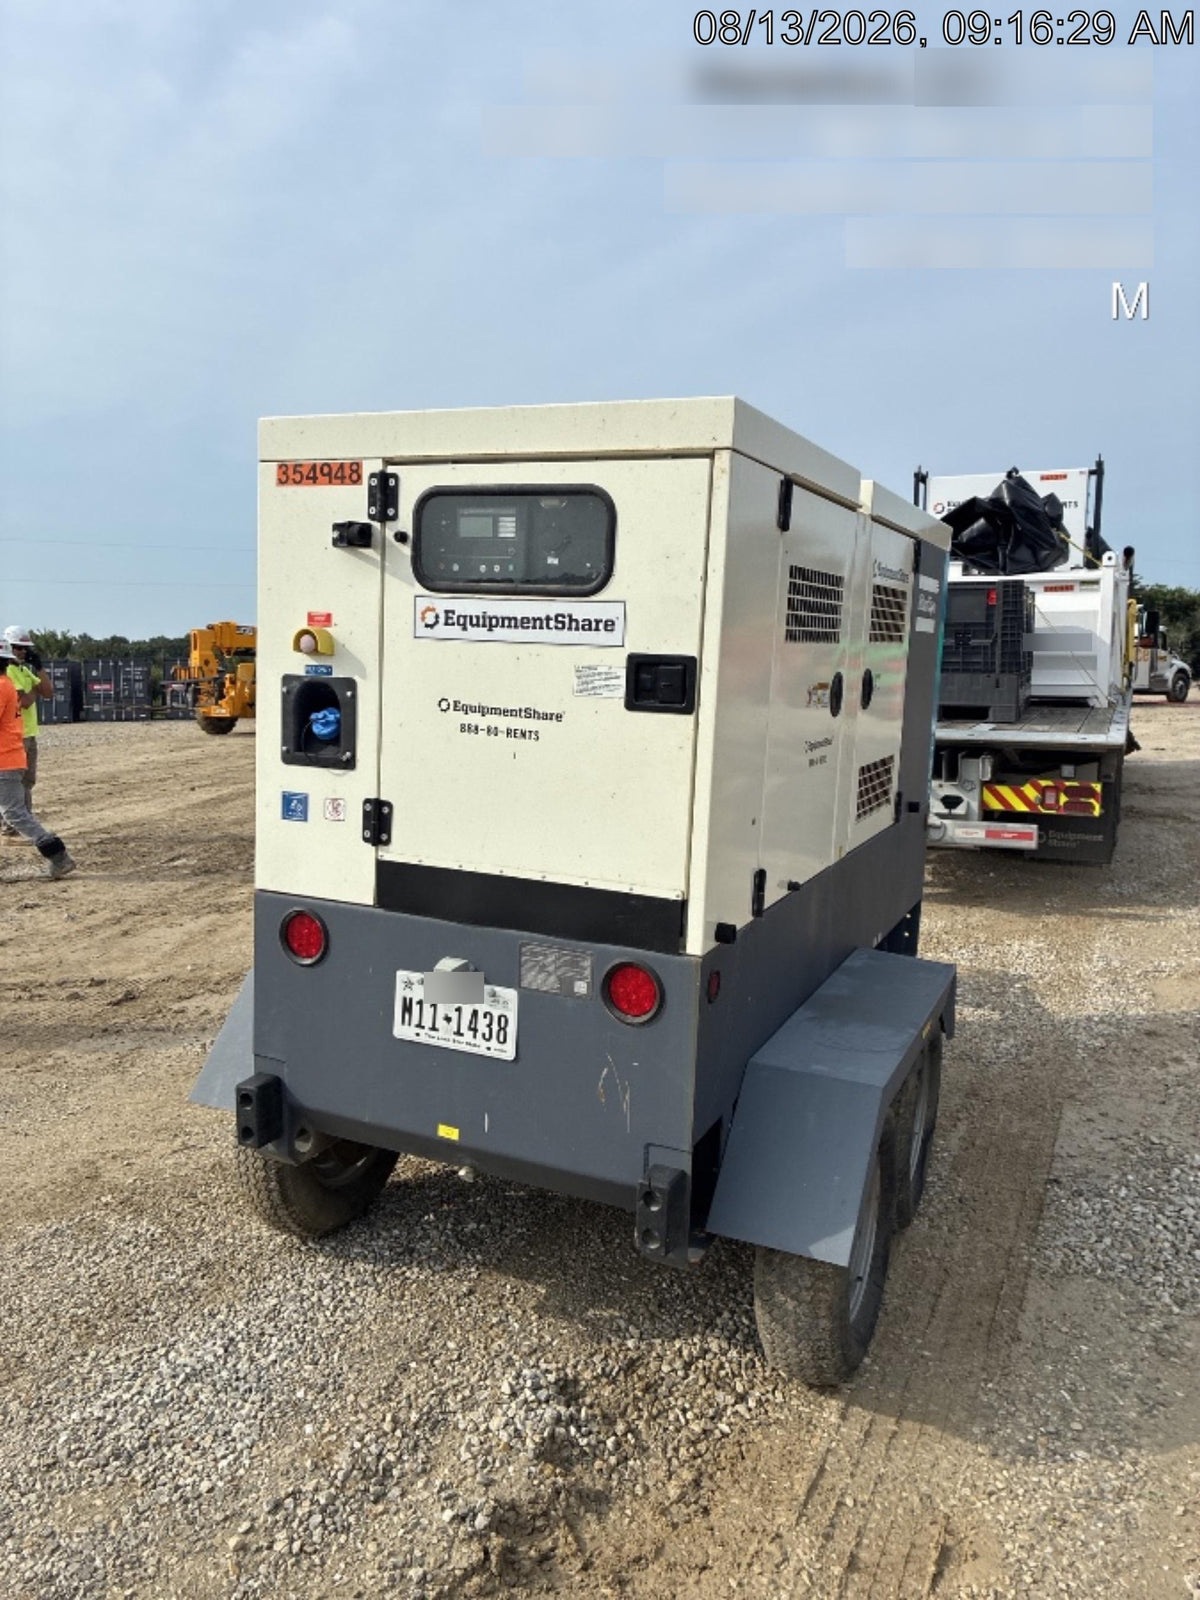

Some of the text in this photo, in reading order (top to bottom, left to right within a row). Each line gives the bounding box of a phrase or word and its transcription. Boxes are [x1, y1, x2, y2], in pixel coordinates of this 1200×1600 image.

[277, 462, 361, 484] 354948
[443, 608, 616, 632] EquipmentShare
[452, 700, 563, 723] EquipmentShare
[459, 723, 540, 741] 888-80-RENTS
[452, 1006, 509, 1045] 1438
